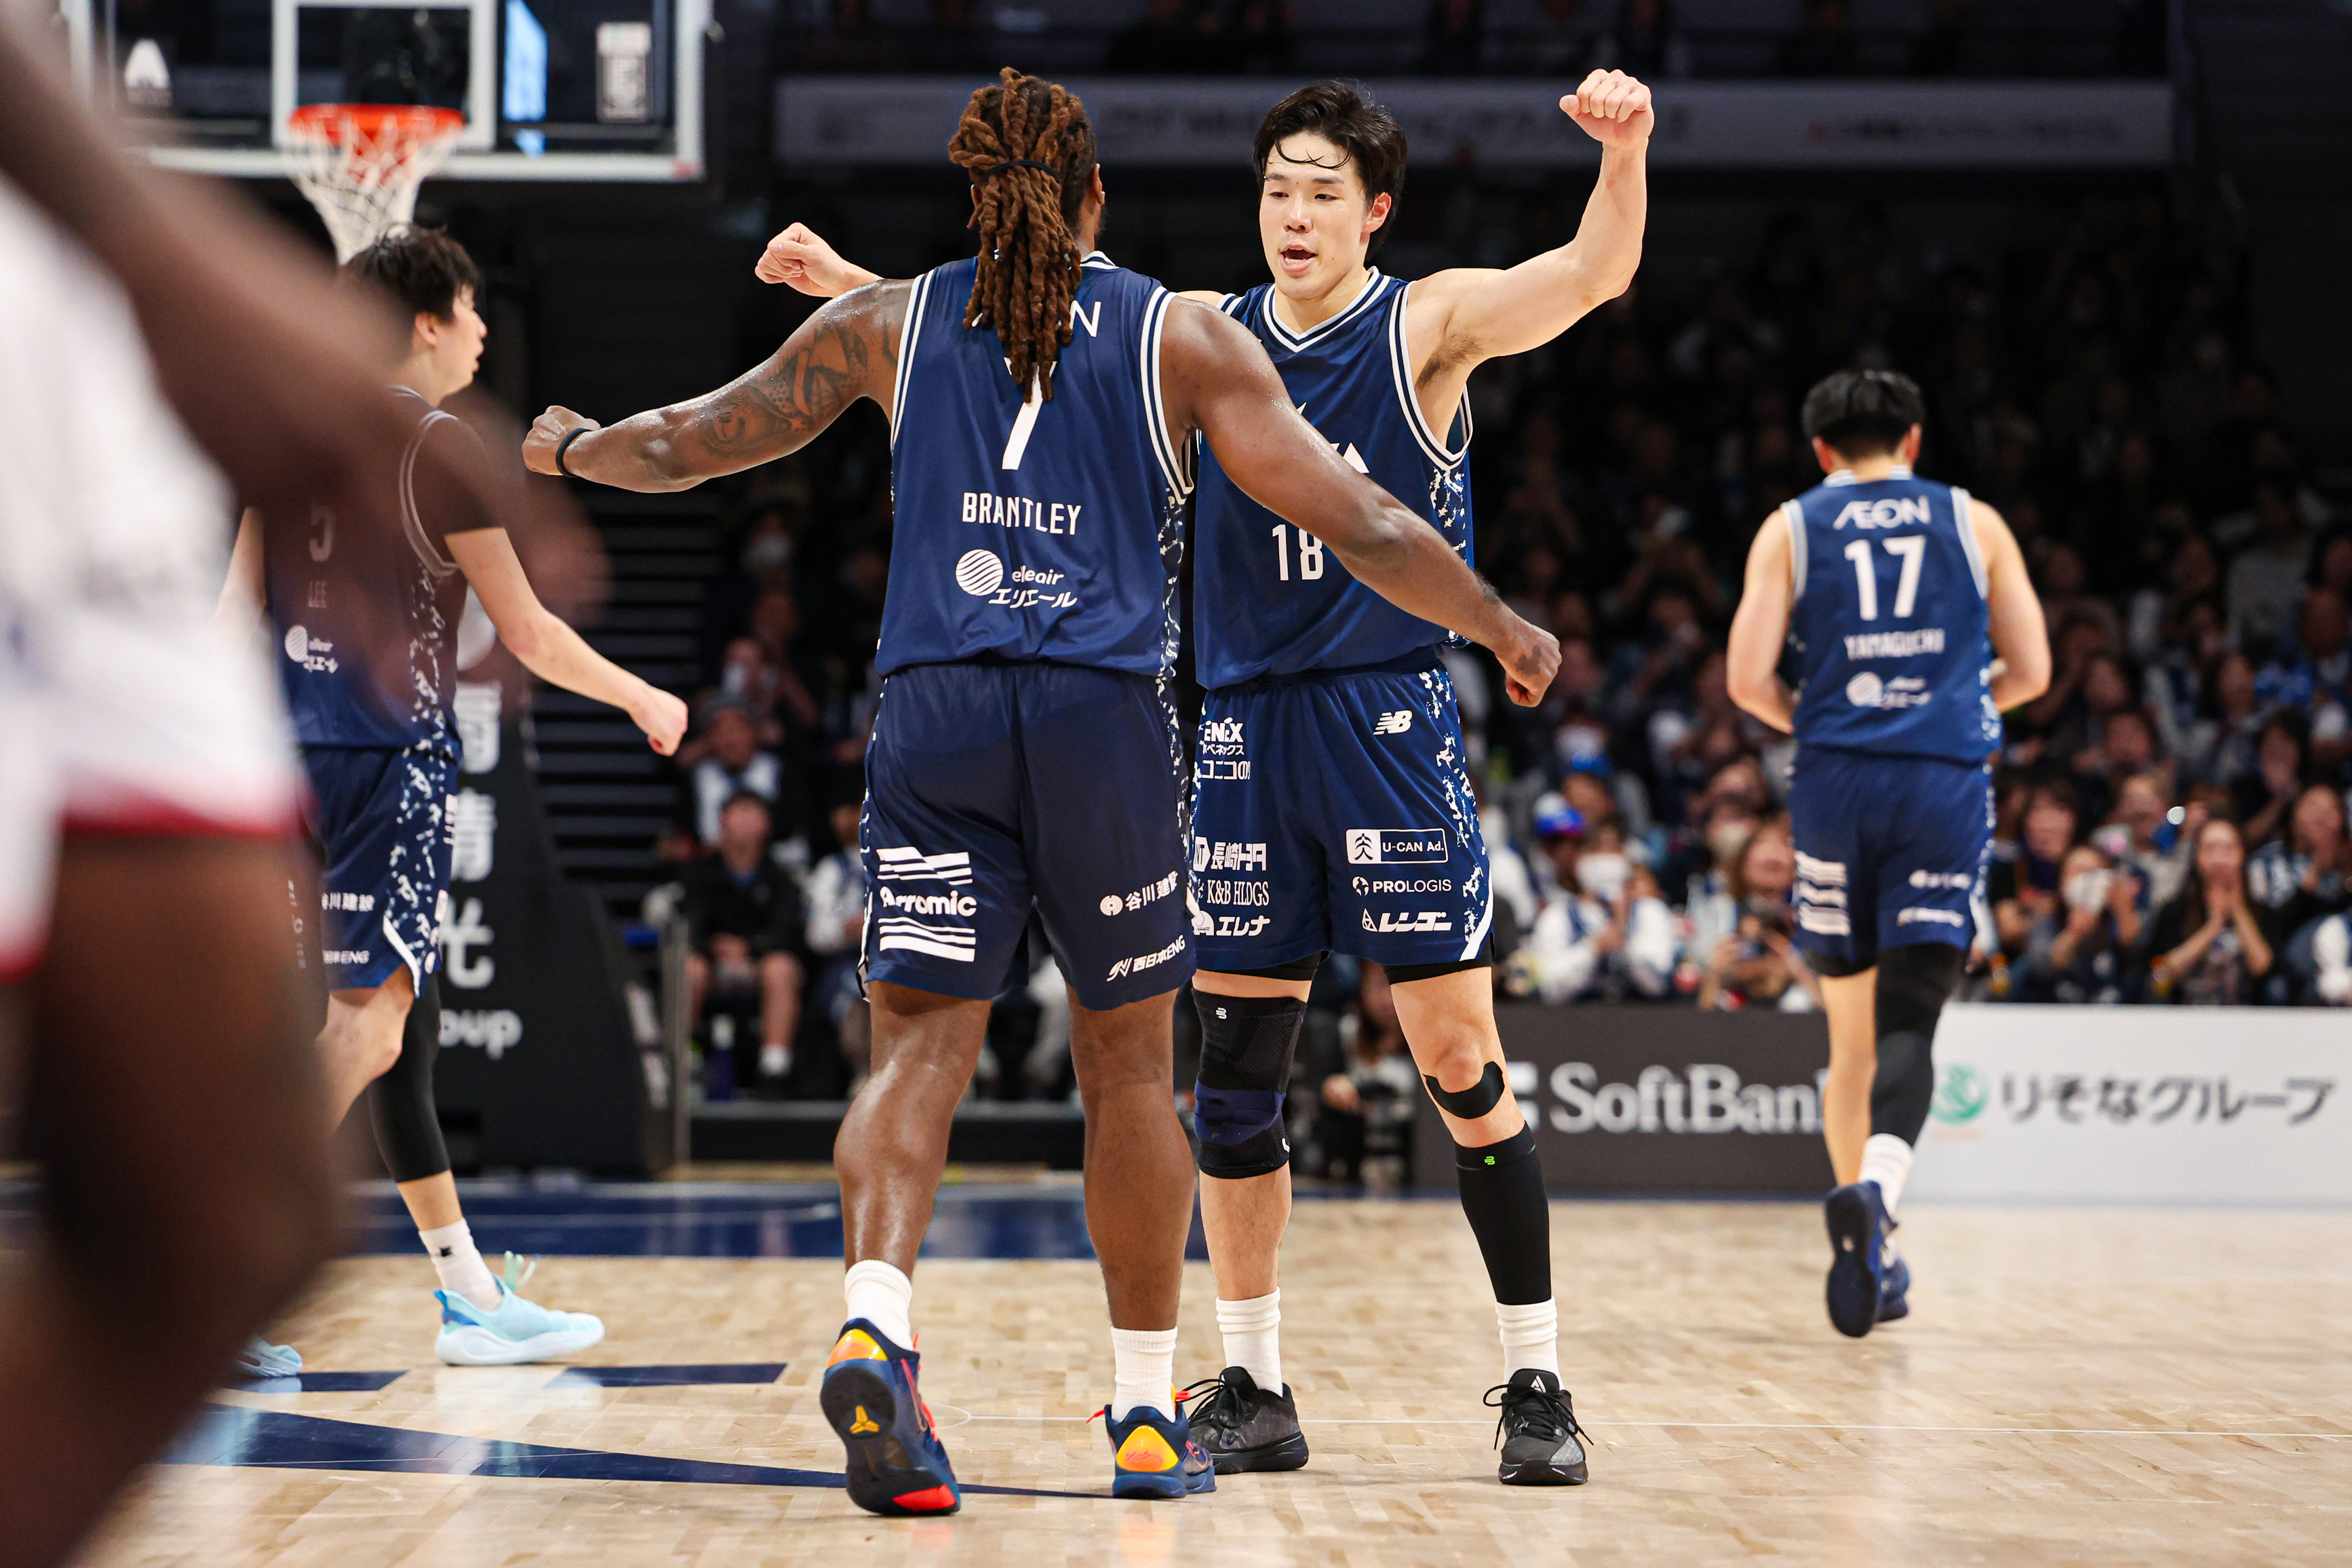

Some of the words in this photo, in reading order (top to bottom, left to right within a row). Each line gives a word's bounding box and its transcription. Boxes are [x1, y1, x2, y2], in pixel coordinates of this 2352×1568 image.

[1002, 357, 1057, 470] 7
[962, 492, 1082, 535] BRANTLEY
[1272, 524, 1323, 581] 18
[1011, 565, 1064, 585] eleair
[1844, 534, 1926, 621] 17
[988, 588, 1078, 608] エリエール
[1843, 628, 1945, 661] YAMAGUCHI
[1211, 842, 1267, 871] 長崎トヨタ
[1382, 842, 1423, 852] U-CAN
[1427, 841, 1445, 852] Ad.
[880, 886, 977, 917] Arromic
[1125, 871, 1179, 912] 谷川建設
[1207, 879, 1232, 905] K&B
[1233, 881, 1270, 907] HLDGS
[1373, 879, 1452, 893] PROLOGIS
[1216, 916, 1271, 937] エレナ
[1133, 935, 1186, 973] 西日本ENG
[2001, 1073, 2337, 1126] りそなグループ
